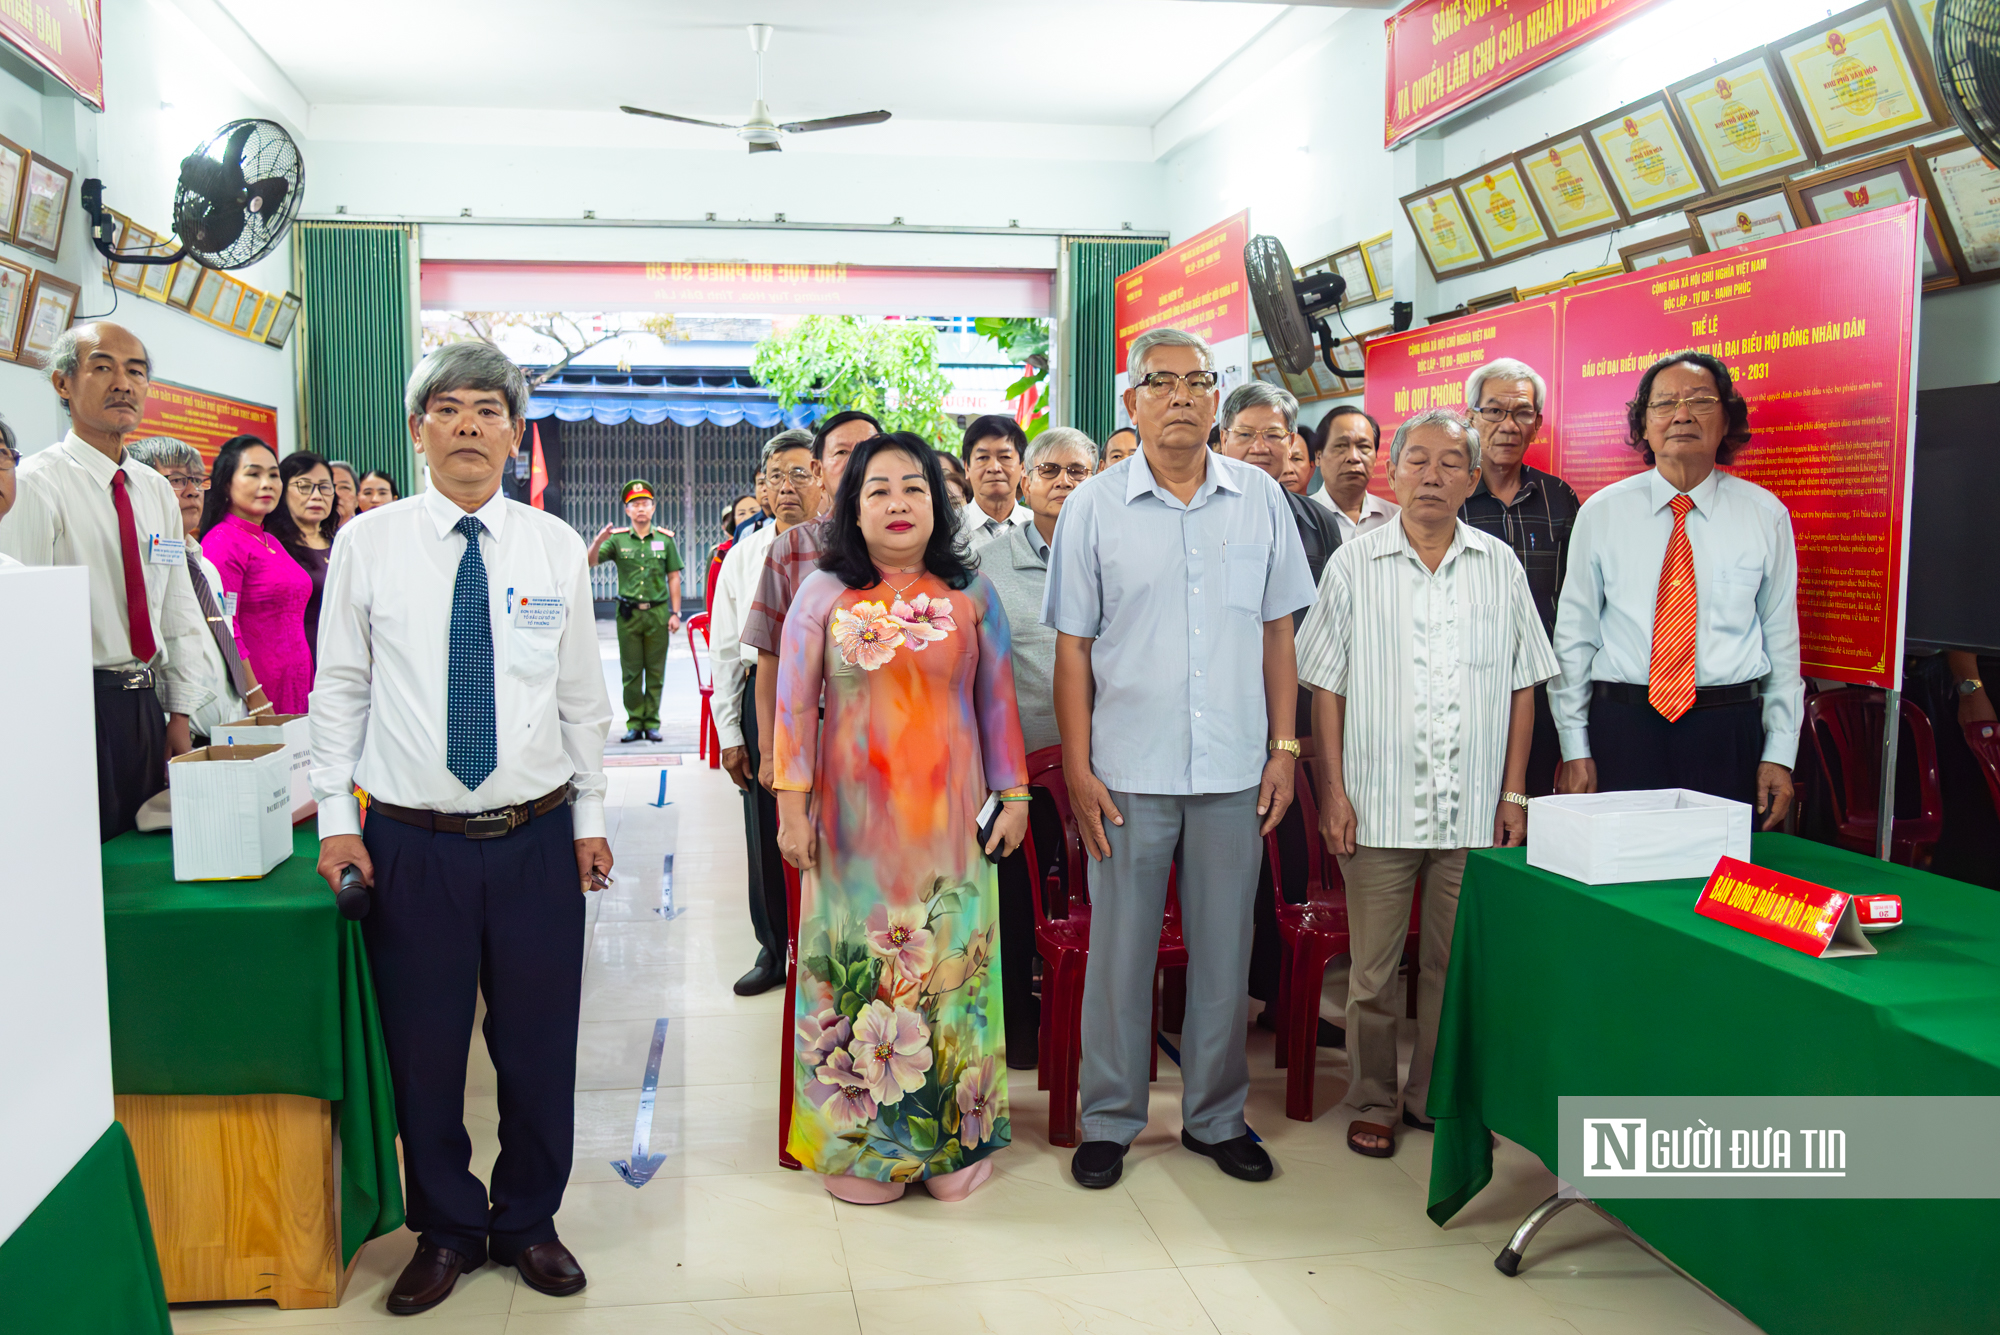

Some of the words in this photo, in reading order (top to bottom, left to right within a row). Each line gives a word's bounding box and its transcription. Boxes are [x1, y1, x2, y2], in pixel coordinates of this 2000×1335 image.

[1432, 0, 1461, 45] SÁNG
[1398, 80, 1410, 120] VÀ
[1412, 60, 1444, 114] QUYỀN
[1446, 51, 1470, 95] LÀM
[1472, 25, 1496, 79] CHỦ
[1499, 13, 1523, 64] CỦA
[1651, 281, 1667, 296] CỘNG
[1668, 277, 1680, 291] HÒA
[1681, 274, 1689, 288] XÃ
[1690, 271, 1701, 287] HỘI
[1702, 267, 1714, 284] CHỦ
[1715, 264, 1735, 280] NGHĨA
[1736, 260, 1750, 277] VIỆT
[1751, 258, 1767, 273] NAM
[1664, 296, 1675, 312] ĐỘC
[1676, 293, 1688, 309] LẬP
[1692, 291, 1701, 306] TỰ
[1701, 290, 1710, 303] DO
[1715, 285, 1733, 301] HẠNH
[1733, 279, 1751, 295] PHÚC
[1691, 313, 1707, 337] THỂ
[1708, 314, 1718, 336] LỆ
[1607, 359, 1619, 377] ĐẠI
[1620, 351, 1637, 373] BIỂU
[1712, 340, 1722, 358] VÀ
[1724, 340, 1739, 359] ĐẠI
[1741, 330, 1762, 354] BIỂU
[1764, 330, 1780, 353] HỘI
[1782, 325, 1809, 348] ĐỒNG
[1811, 321, 1840, 344] NHÂN
[1843, 317, 1866, 339] DÂN
[1747, 362, 1769, 380] 2031
[1394, 386, 1409, 416] NỘI
[1411, 387, 1428, 412] QUY
[1430, 378, 1463, 408] PHÒNG
[1709, 872, 1736, 904] BÀN
[1727, 878, 1759, 912] ĐÓNG
[1751, 883, 1778, 919] DẤU
[1770, 892, 1794, 924] ĐÃ
[1783, 893, 1809, 928] BỎ
